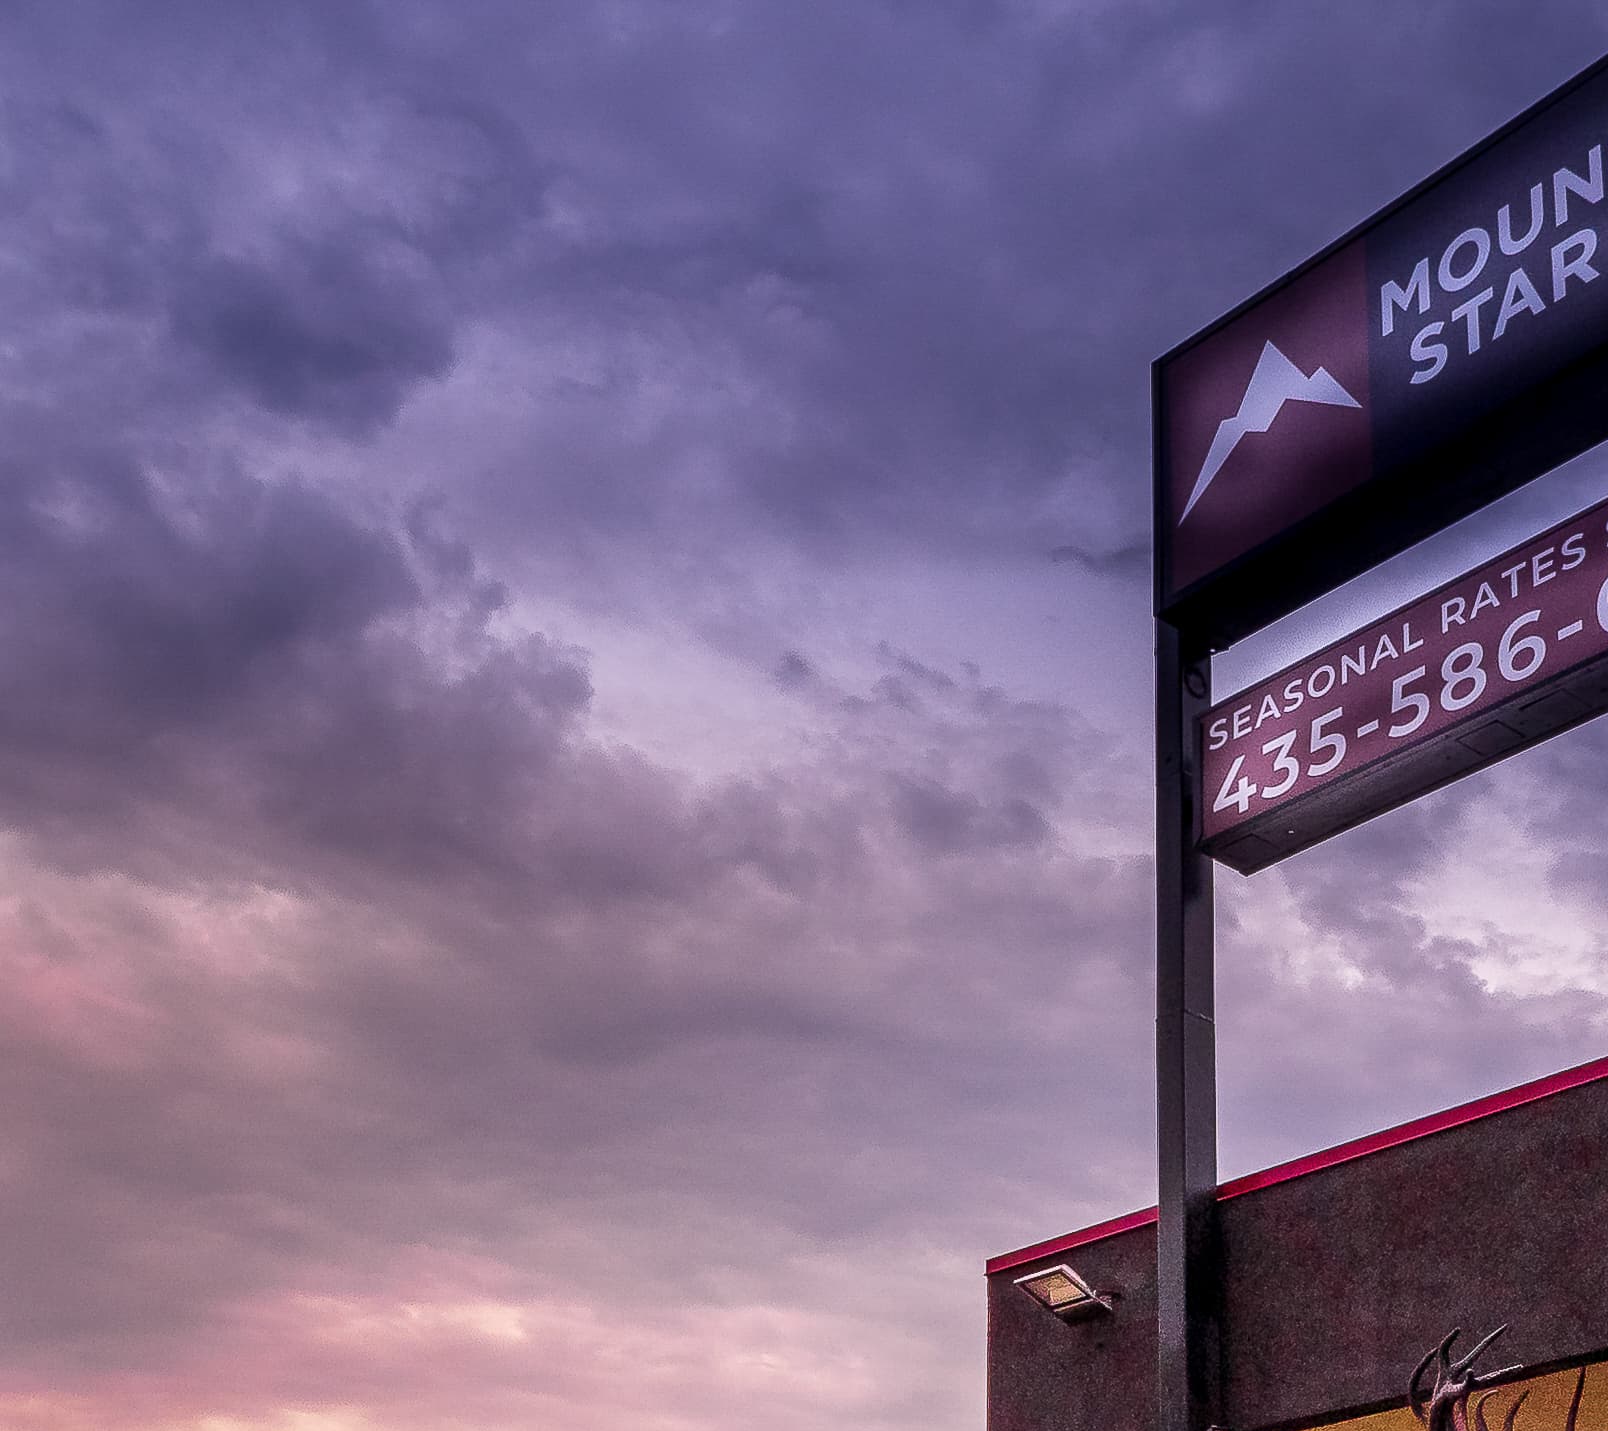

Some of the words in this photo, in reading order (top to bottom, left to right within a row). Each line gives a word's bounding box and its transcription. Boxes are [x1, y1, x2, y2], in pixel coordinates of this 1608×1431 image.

[1409, 228, 1601, 385] STAR
[1208, 622, 1425, 751] SEASONAL
[1440, 532, 1587, 635] RATES
